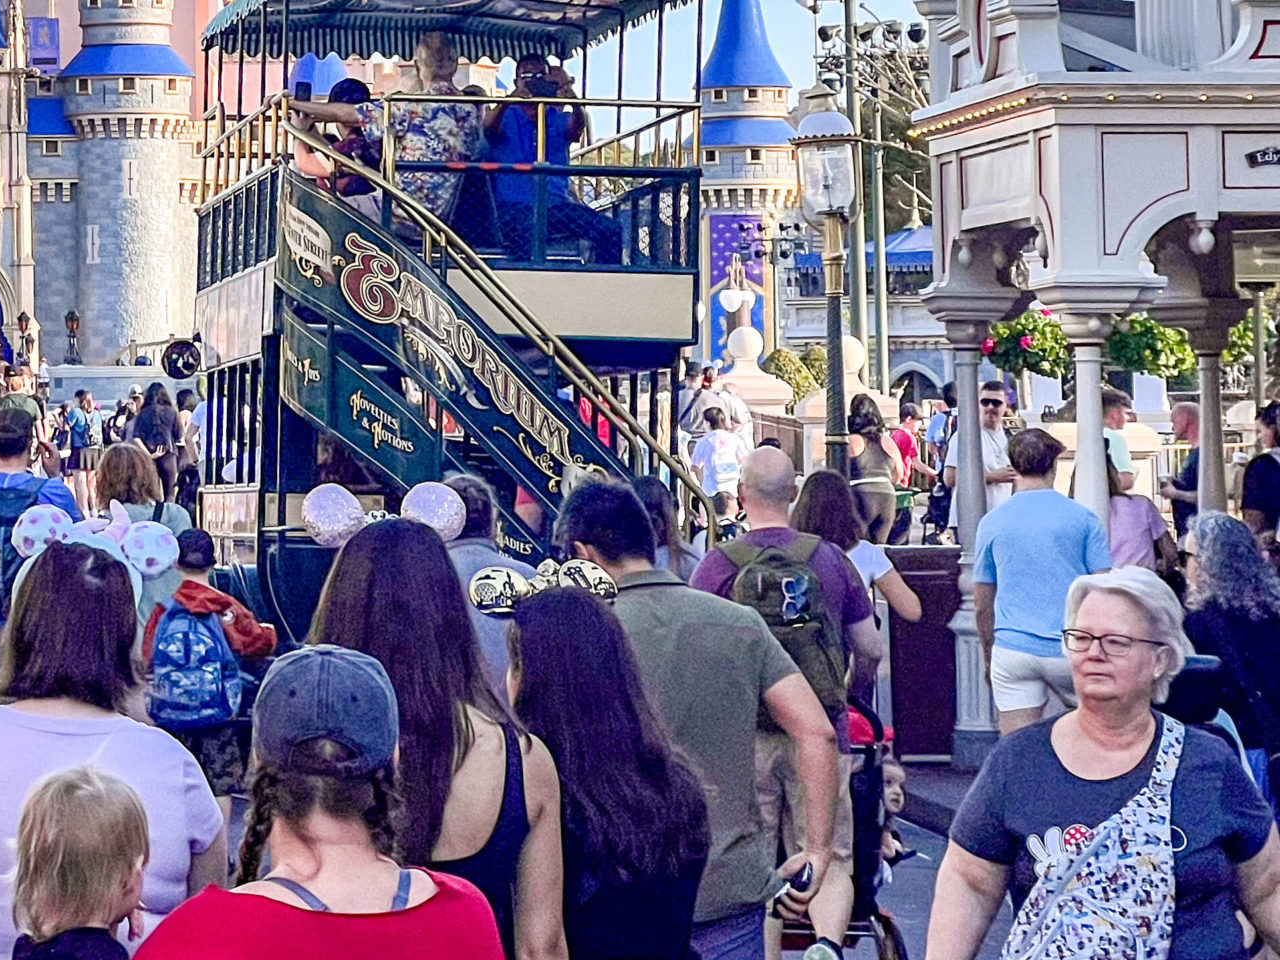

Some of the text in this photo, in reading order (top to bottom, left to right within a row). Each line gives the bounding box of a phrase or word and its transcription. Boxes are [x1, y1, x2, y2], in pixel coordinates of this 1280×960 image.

[341, 232, 573, 466] EMPORIUM
[350, 389, 399, 430] NOVELTIES
[361, 416, 414, 453] & NOTIONS
